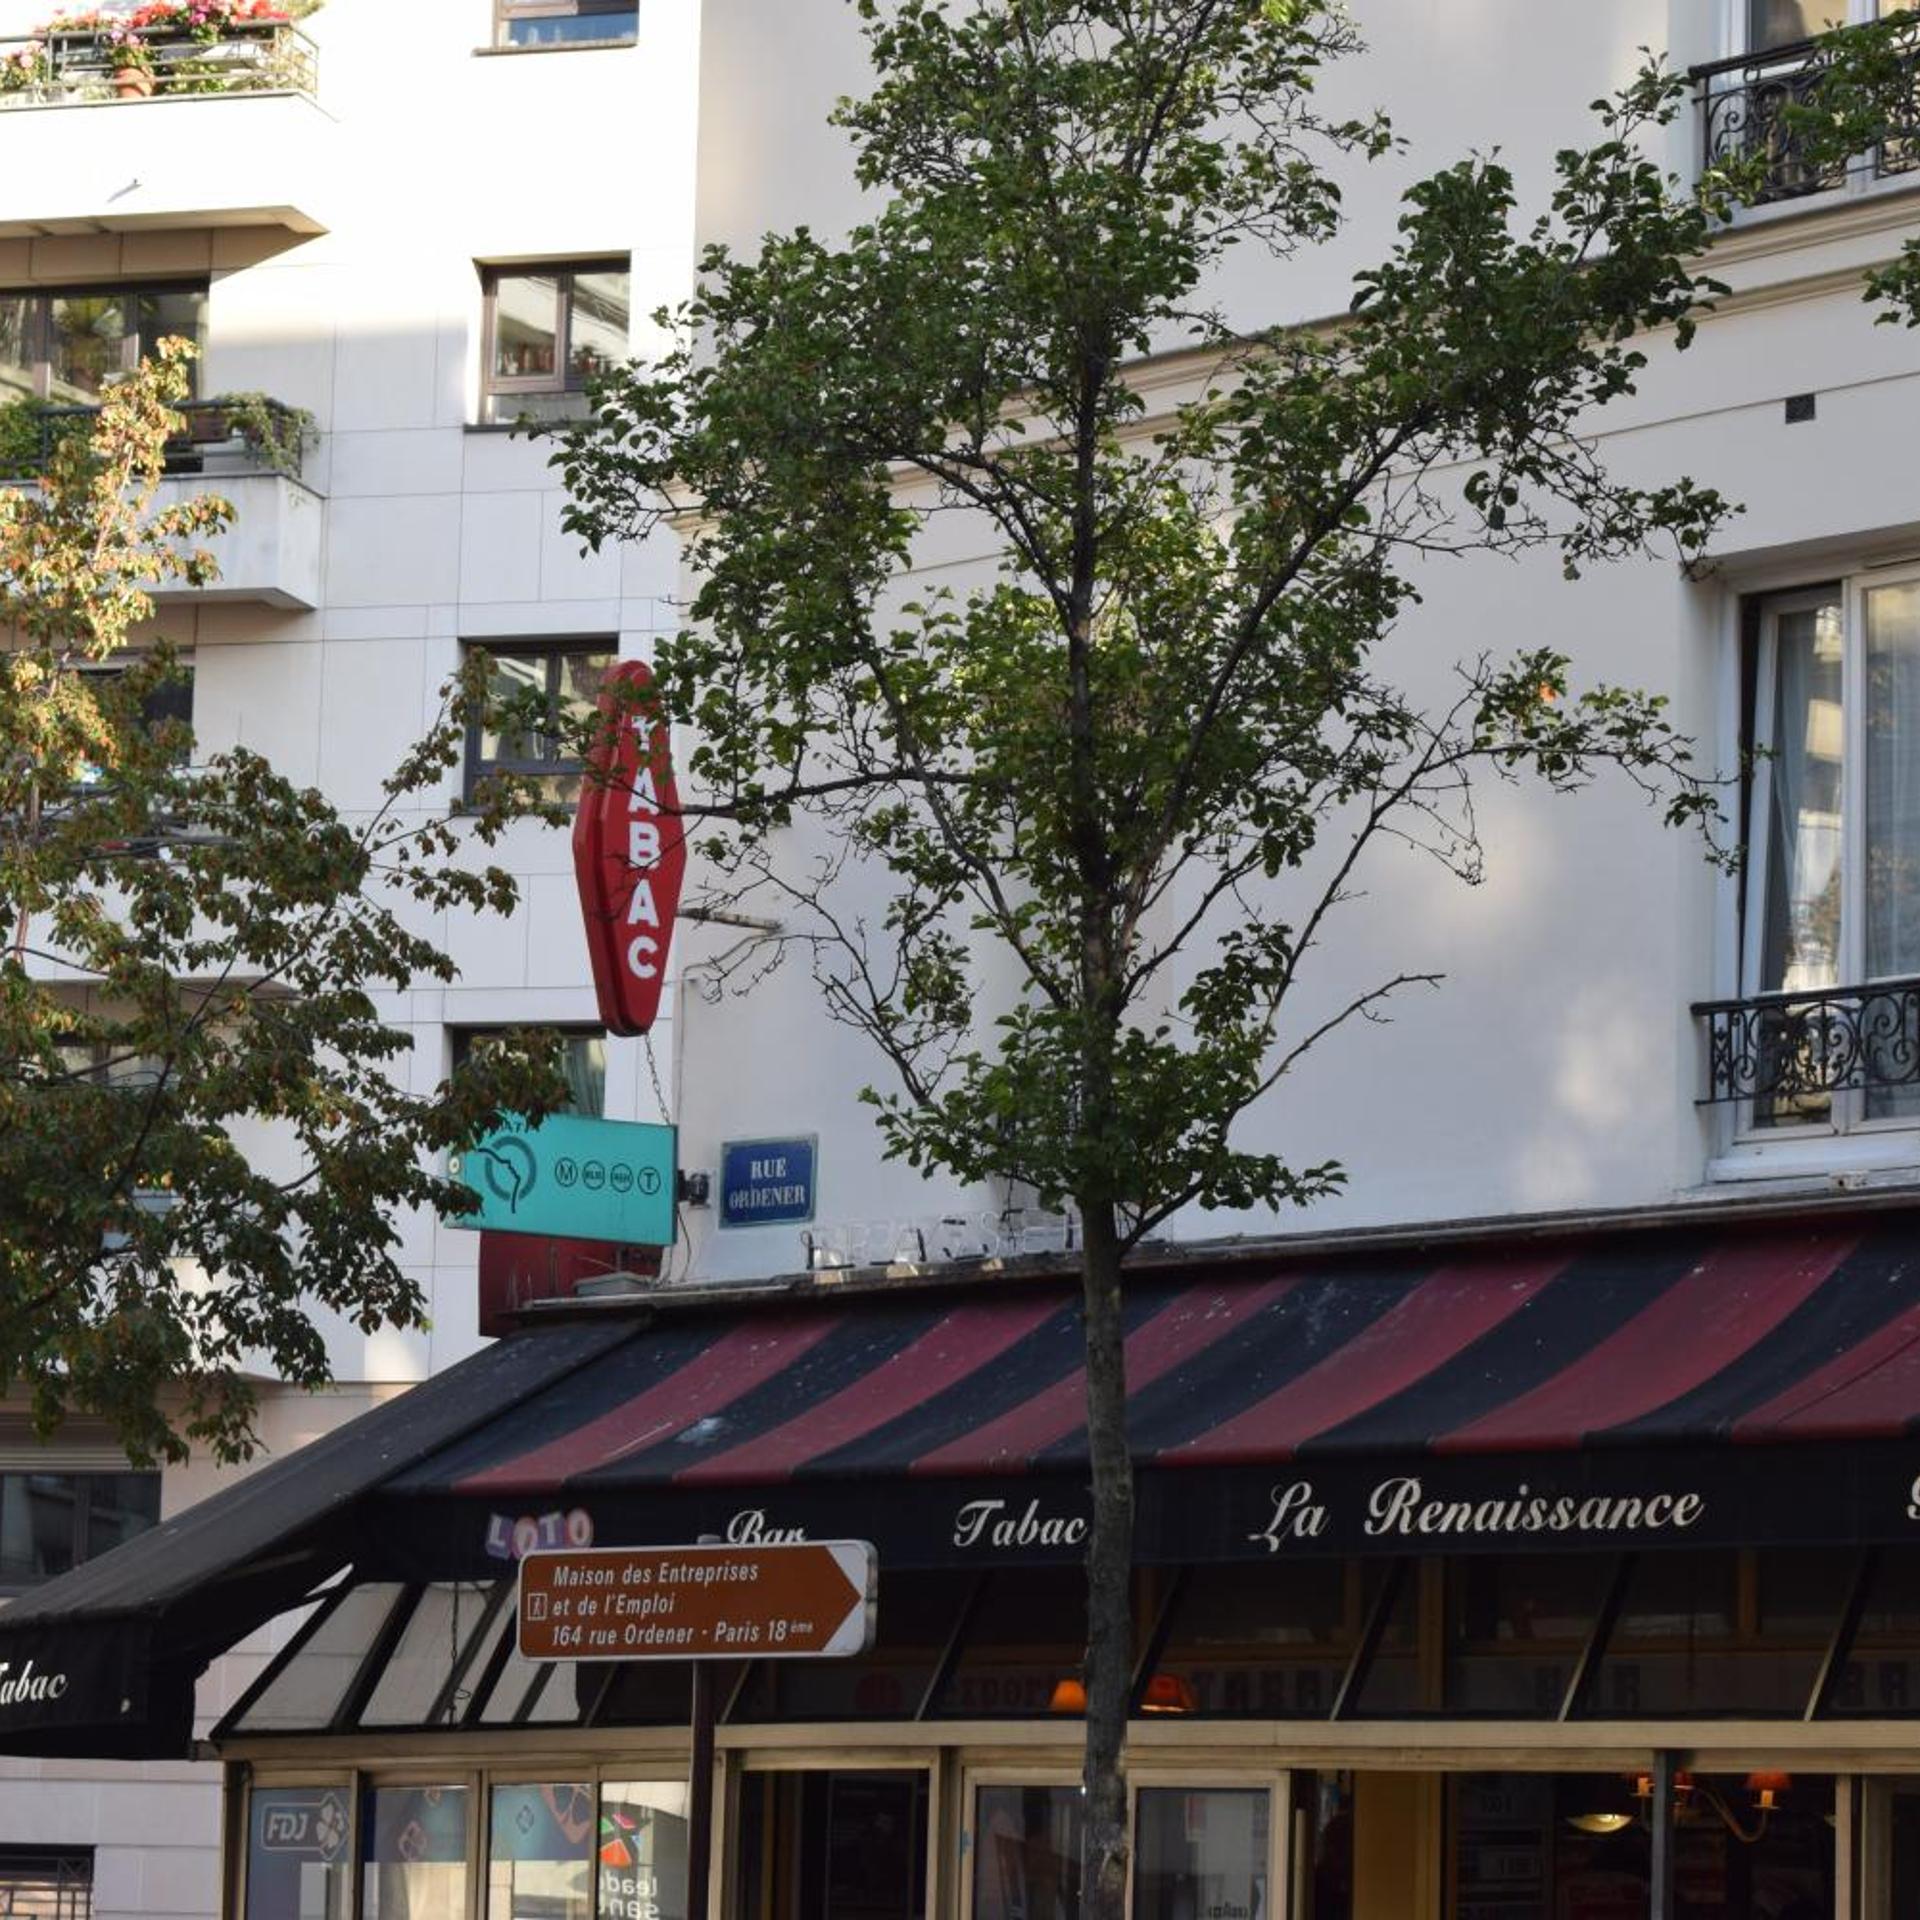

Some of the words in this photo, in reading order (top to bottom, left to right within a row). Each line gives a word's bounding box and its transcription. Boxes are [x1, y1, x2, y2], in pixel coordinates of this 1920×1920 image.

[627, 715, 661, 978] TABAC
[751, 1157, 786, 1179] RUE
[729, 1185, 805, 1209] ORDENER
[727, 1509, 806, 1543] Bar
[954, 1499, 1088, 1546] Tabac
[1248, 1482, 1330, 1552] La
[1364, 1478, 1704, 1535] Renaissance
[487, 1509, 593, 1558] LOTO
[554, 1566, 615, 1586] Maison
[622, 1564, 652, 1584] des
[659, 1561, 759, 1589] Entreprises
[553, 1598, 571, 1616] et
[578, 1596, 598, 1616] de
[604, 1592, 676, 1619] l'Emploi
[553, 1625, 583, 1646] 164
[589, 1629, 617, 1644] rue
[625, 1623, 694, 1644] Ordener
[715, 1620, 760, 1642] Paris
[267, 1812, 309, 1841] FDJ
